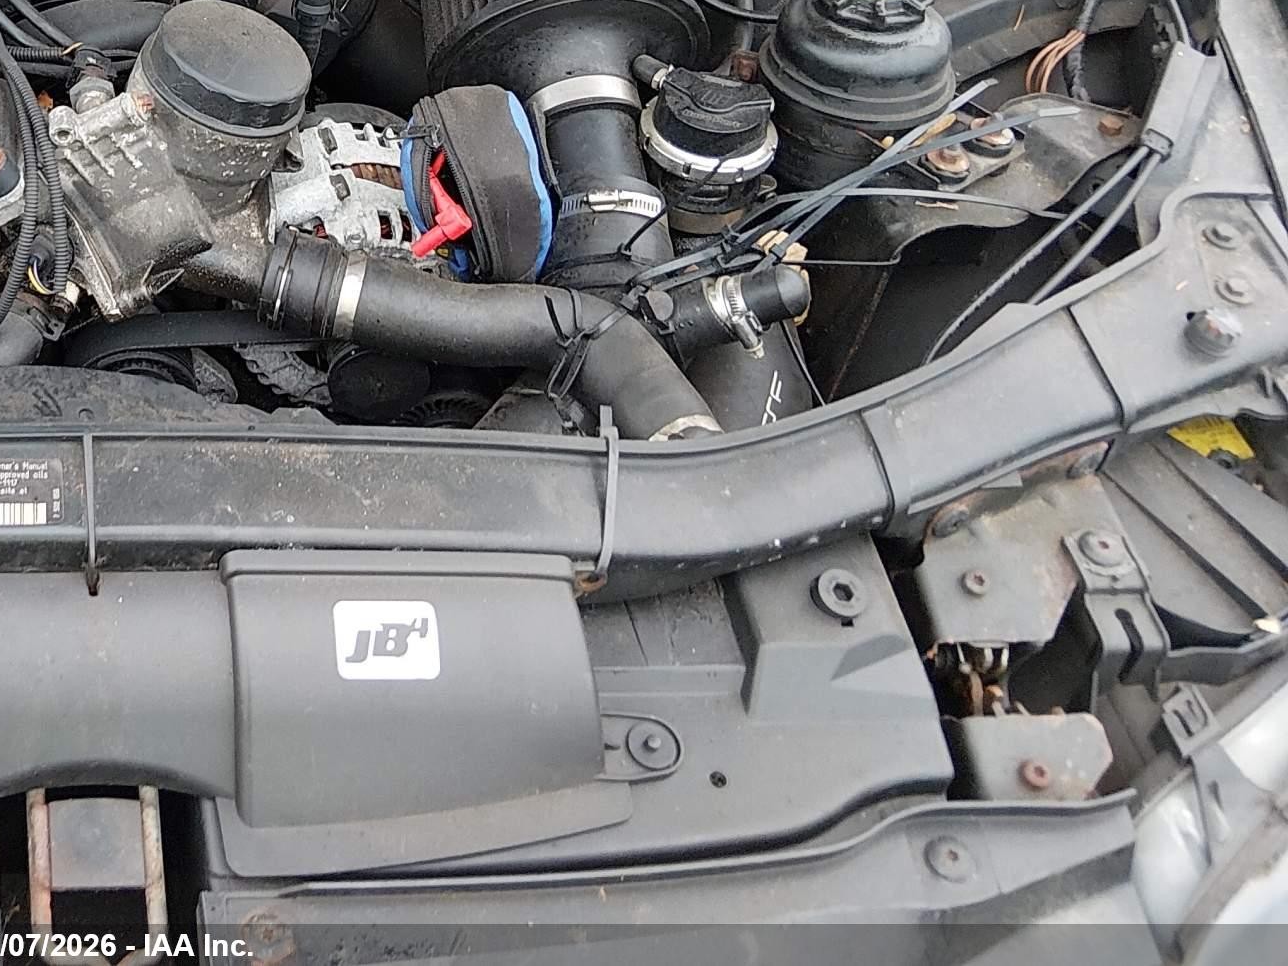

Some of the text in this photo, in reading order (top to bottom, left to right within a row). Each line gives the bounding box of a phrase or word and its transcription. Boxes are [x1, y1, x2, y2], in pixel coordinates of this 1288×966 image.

[22, 461, 48, 471] Manual
[33, 470, 48, 479] oils
[0, 486, 15, 495] site
